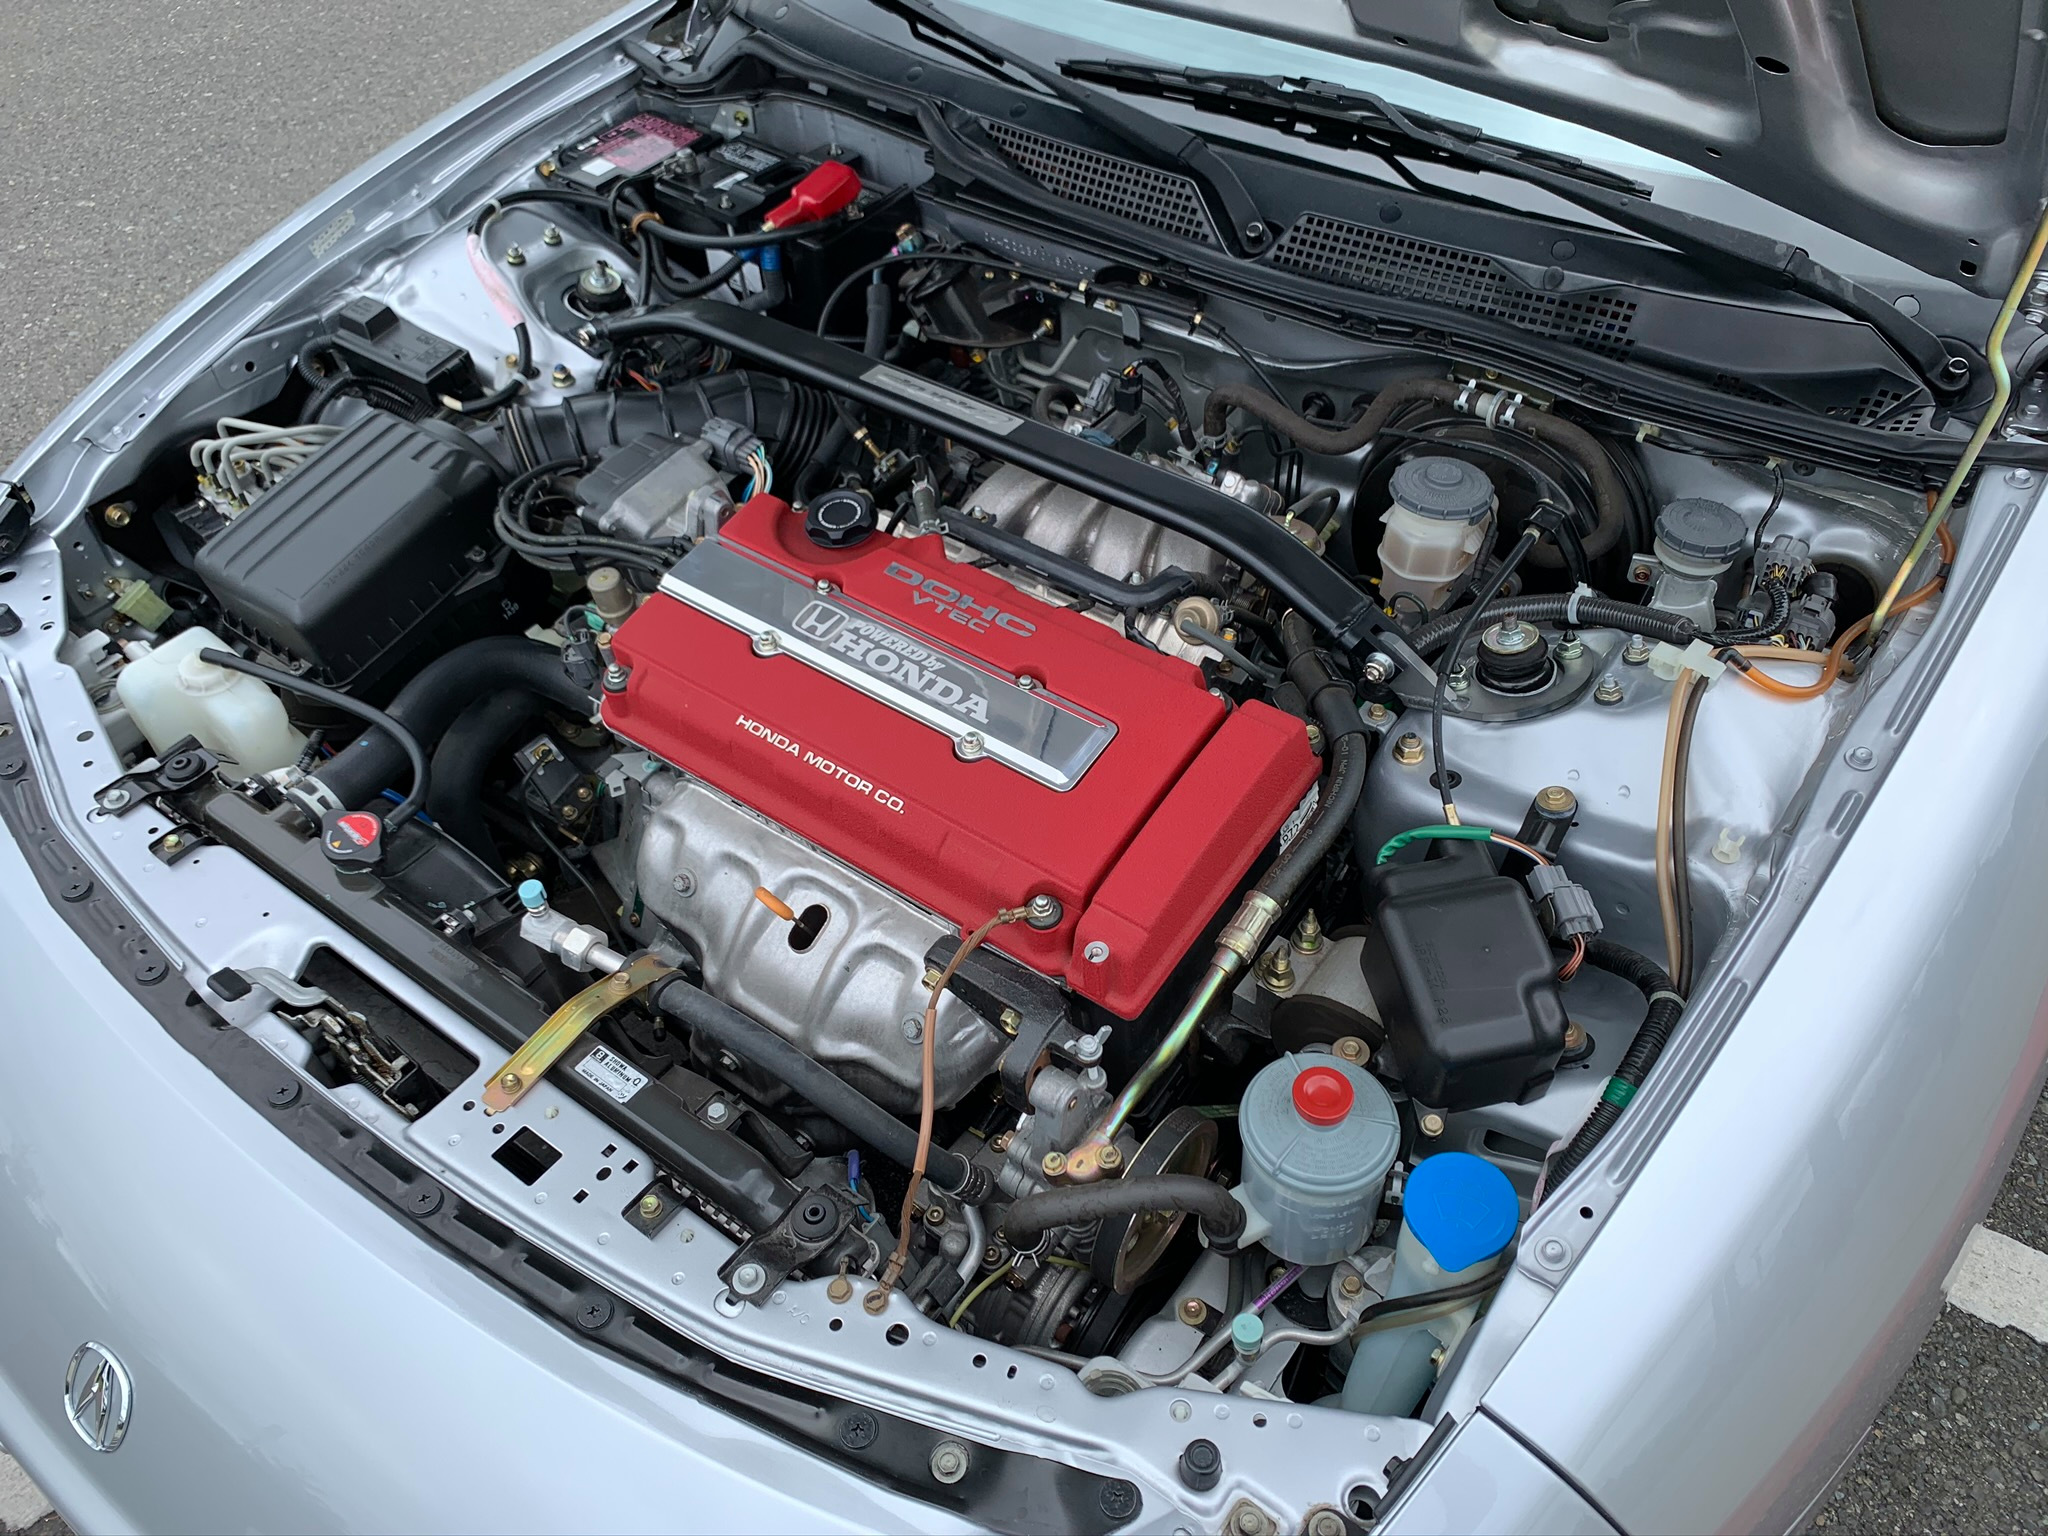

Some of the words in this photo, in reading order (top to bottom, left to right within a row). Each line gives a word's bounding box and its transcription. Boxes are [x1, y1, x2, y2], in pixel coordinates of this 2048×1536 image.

[884, 561, 1036, 637] DOHC
[913, 590, 991, 633] VTEC
[848, 619, 930, 664] POWERED
[925, 653, 946, 671] by
[829, 631, 989, 724] HONDA
[735, 714, 800, 756] HONDA
[803, 751, 873, 795] MOTOR
[874, 789, 905, 814] CO.
[582, 1069, 593, 1079] MADE
[599, 1081, 614, 1093] JAPAN
[604, 1062, 632, 1083] ALUMINUM
[609, 1056, 628, 1071] SHOWA
